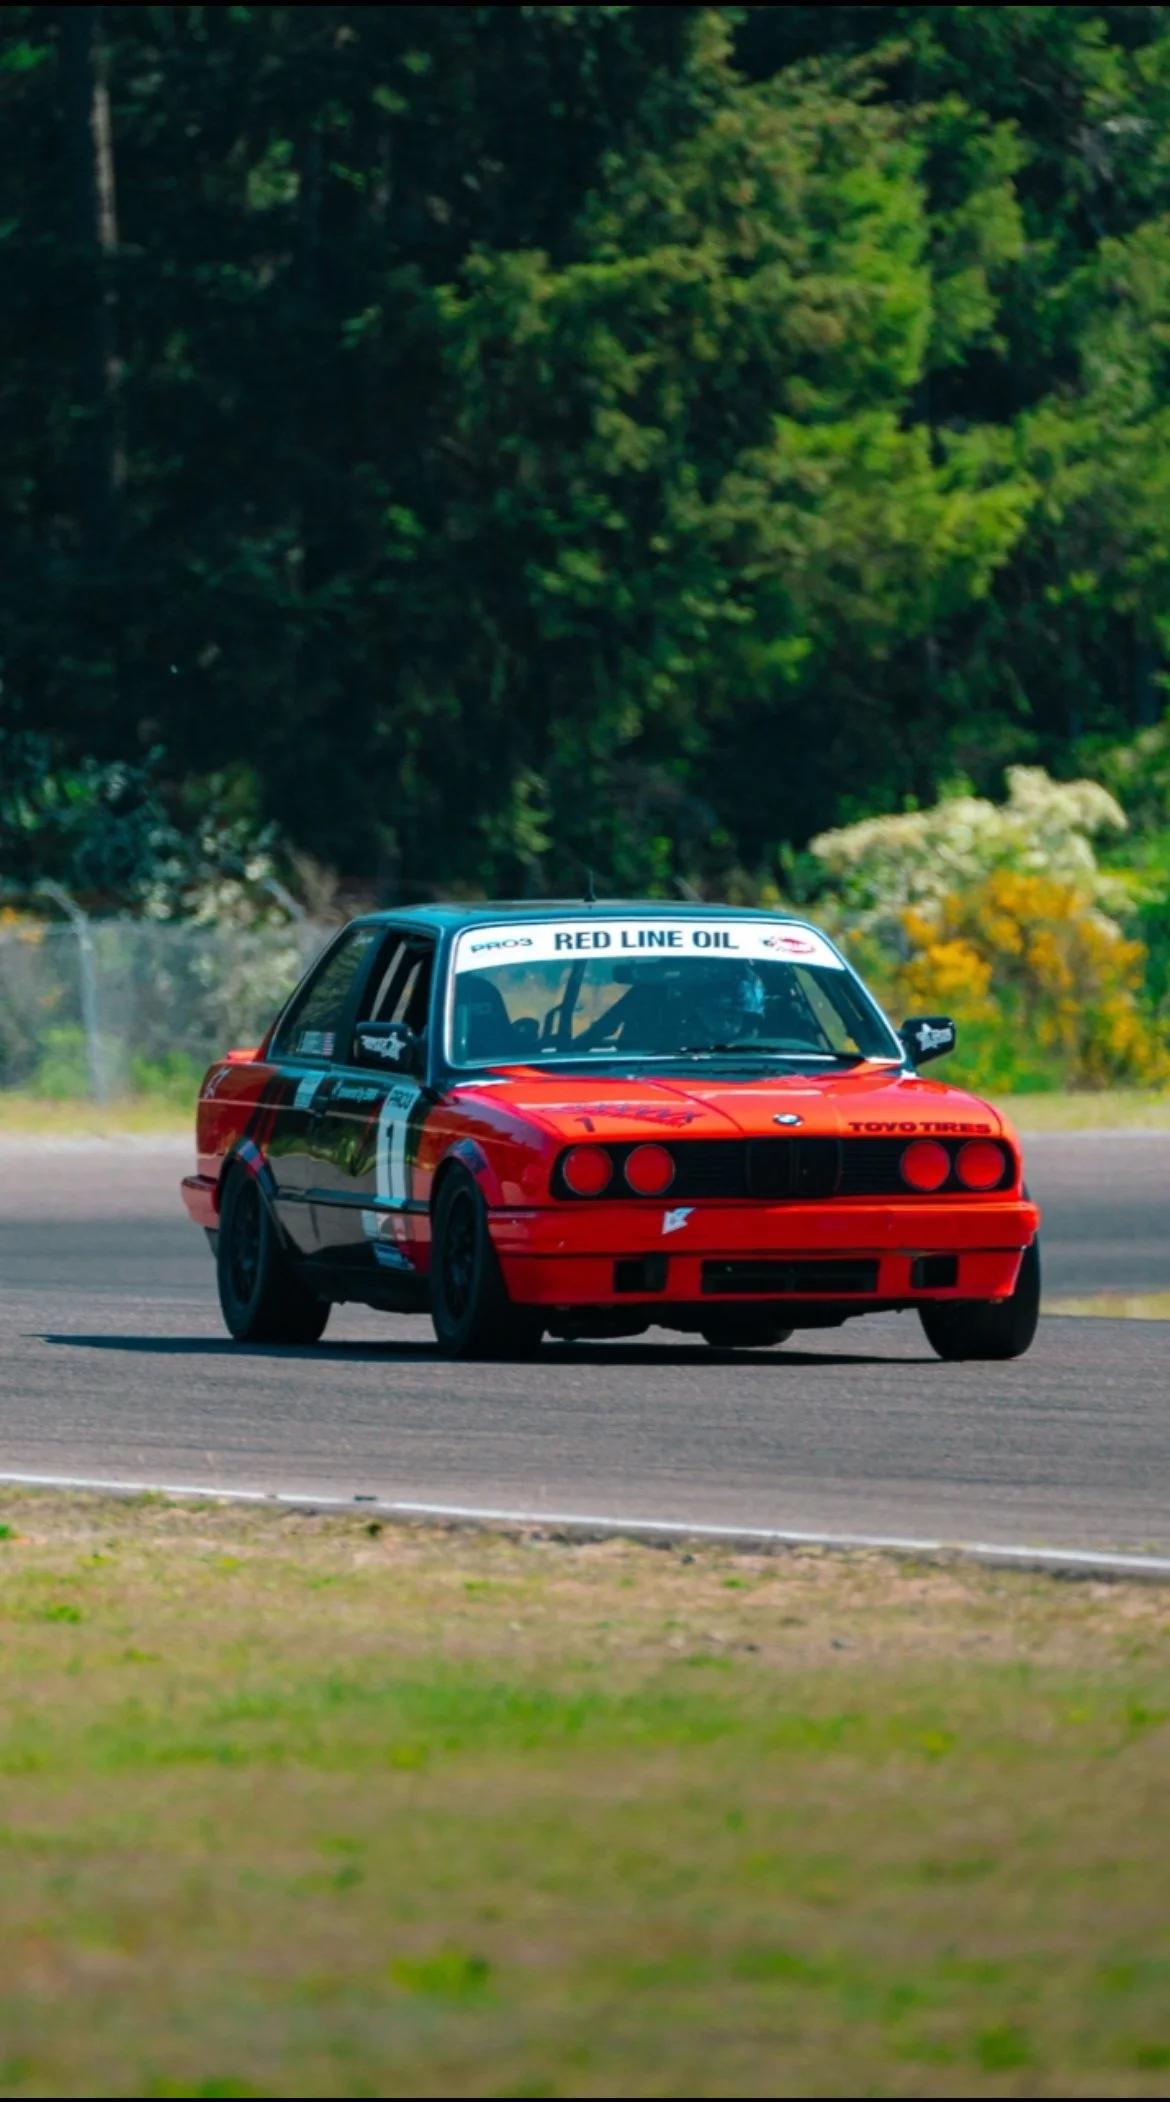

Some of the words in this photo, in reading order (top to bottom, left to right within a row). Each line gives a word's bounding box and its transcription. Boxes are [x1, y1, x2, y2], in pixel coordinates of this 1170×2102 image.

[554, 930, 612, 951] RED
[620, 930, 685, 949] LINE
[691, 930, 741, 950] OIL
[848, 1121, 917, 1133] TOYO
[919, 1122, 992, 1135] TIRES
